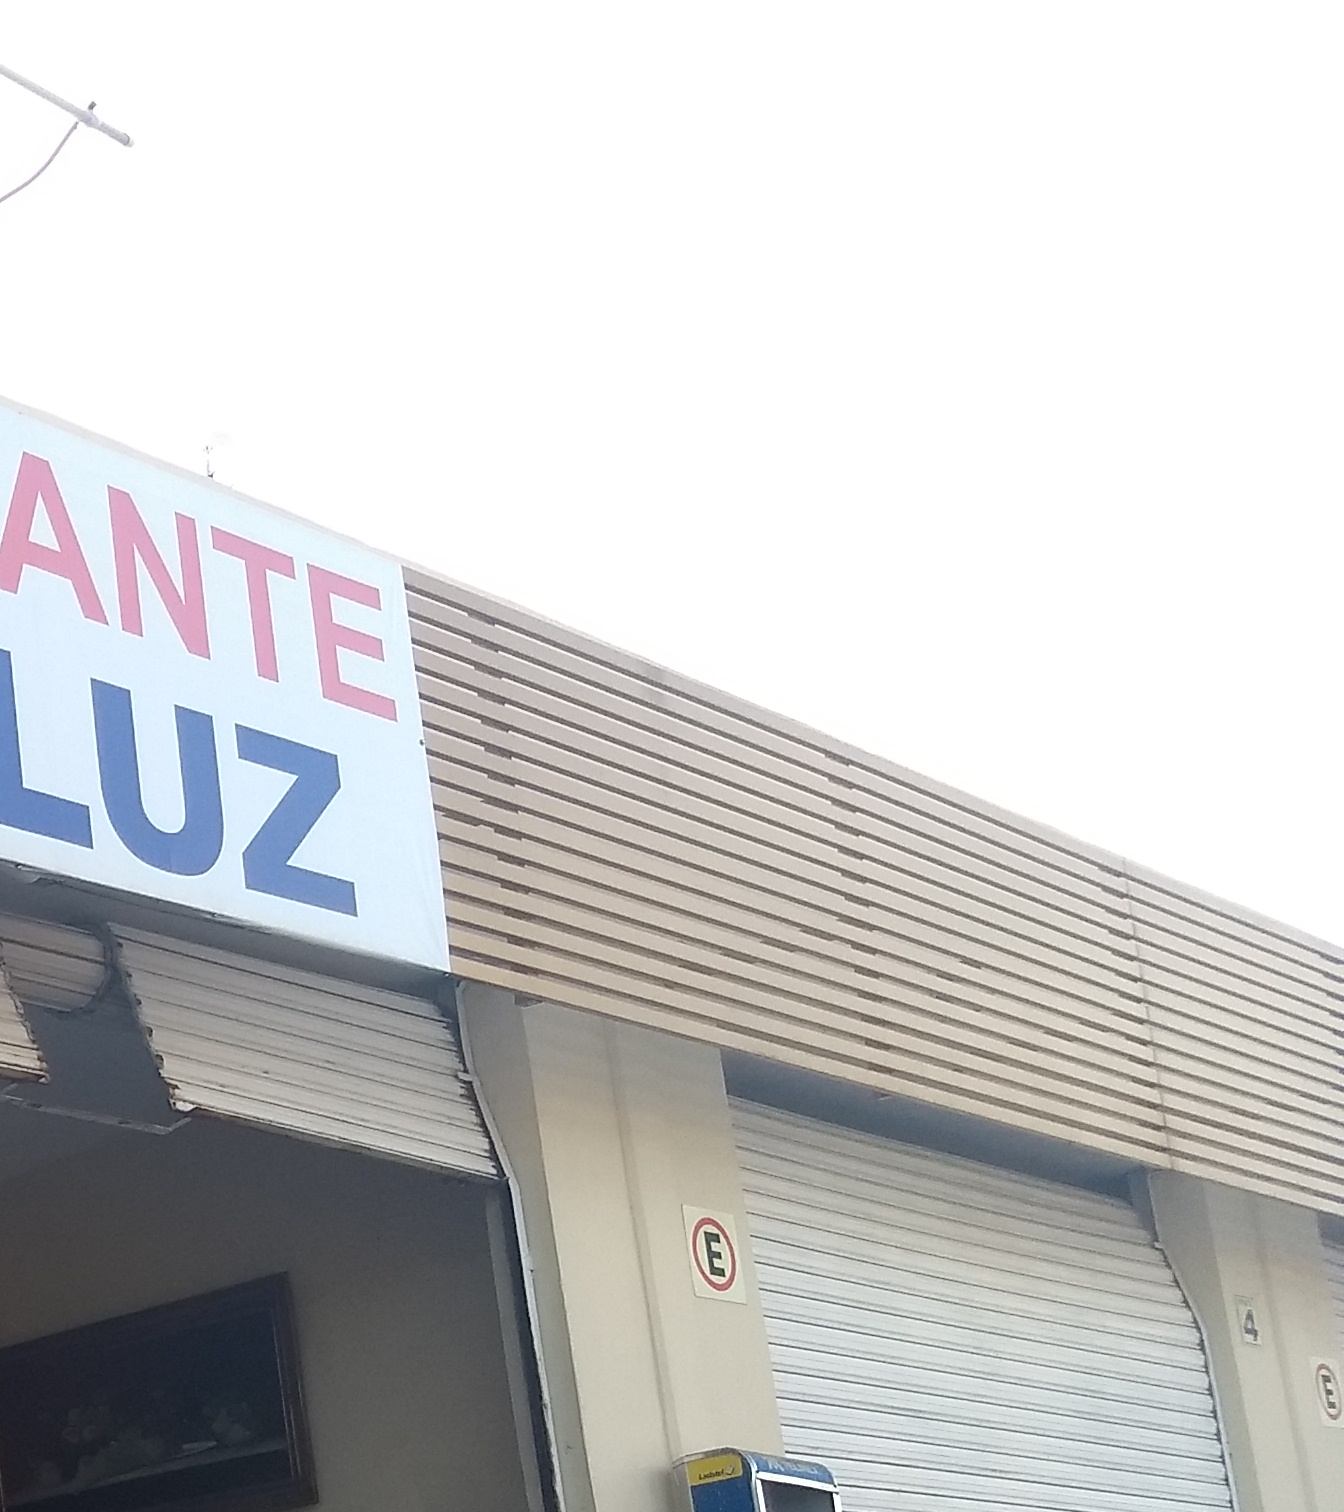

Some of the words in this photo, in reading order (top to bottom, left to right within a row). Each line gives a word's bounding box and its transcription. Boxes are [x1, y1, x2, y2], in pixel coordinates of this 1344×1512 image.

[703, 1230, 726, 1278] E
[1243, 1308, 1258, 1342] 4
[1321, 1374, 1337, 1409] E
